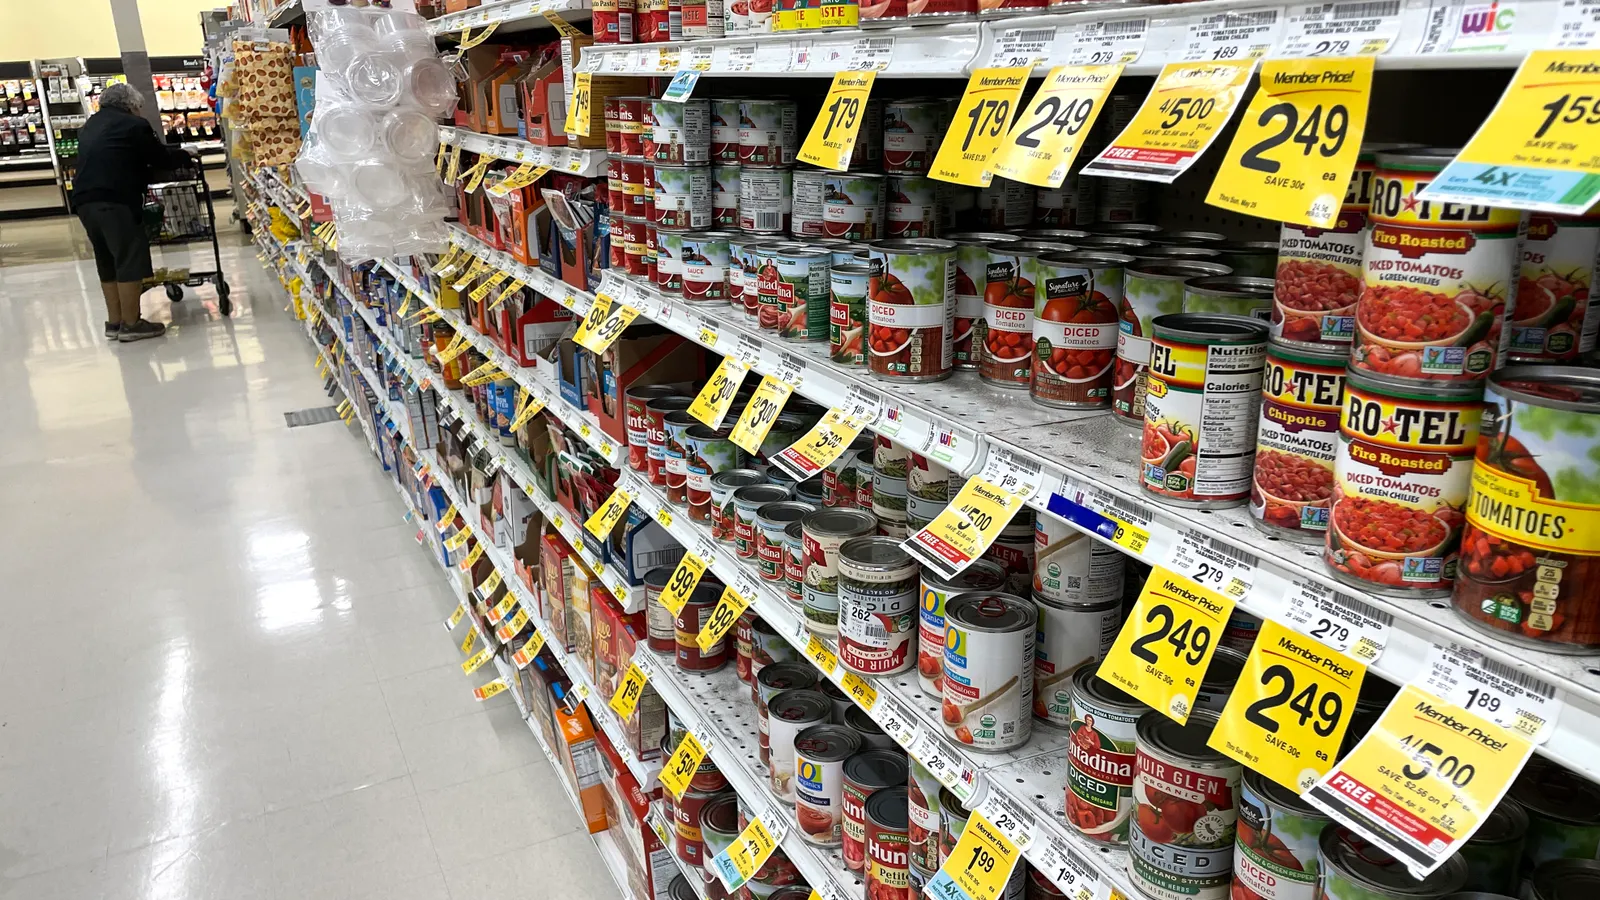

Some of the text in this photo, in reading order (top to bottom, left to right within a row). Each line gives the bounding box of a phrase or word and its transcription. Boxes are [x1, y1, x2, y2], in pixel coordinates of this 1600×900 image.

[1461, 1, 1516, 34] wic
[1212, 46, 1238, 60] 189
[1308, 40, 1350, 56] 279
[979, 76, 1023, 86] Member Price!
[1055, 74, 1110, 83] Member Price!
[1274, 70, 1356, 84] Member Price!
[575, 88, 589, 117] 149
[822, 96, 859, 140] 179
[961, 98, 1010, 152] 179
[1015, 96, 1094, 149] 249
[1240, 102, 1349, 174] 249
[1106, 147, 1138, 159] FREE
[1264, 175, 1305, 190] SAVE 30¢
[1322, 172, 1337, 181] ea
[1472, 166, 1520, 187] 4X
[1299, 239, 1354, 254] TOMATOES
[1374, 230, 1467, 250] Fire Roasted
[687, 267, 704, 275] SAUCE
[1369, 260, 1464, 280] DICED TOMATOES
[1384, 273, 1408, 283] GREEN
[1409, 275, 1440, 286] CHILIES
[1048, 280, 1080, 294] Signature
[760, 295, 777, 304] PAST
[872, 304, 895, 316] DICED
[995, 309, 1026, 321] DICED
[994, 318, 1026, 329] Tomatoes
[1063, 327, 1100, 337] DICED
[1063, 335, 1100, 346] Tomatoes
[1207, 382, 1250, 391] Calories
[887, 405, 903, 422] wic
[1268, 407, 1327, 427] Chipotle
[939, 429, 958, 449] wic
[1279, 432, 1333, 452] TOMATOES
[1352, 445, 1443, 471] Fire Roasted
[1000, 473, 1017, 487] 189
[1347, 472, 1441, 498] DICED TOMATOES
[1490, 481, 1520, 499] CHILES
[1365, 486, 1389, 497] GREEN
[1390, 491, 1420, 503] CHILIES
[600, 502, 623, 522] 199
[1475, 491, 1567, 539] TOMATOES
[919, 530, 939, 546] FREE
[1192, 562, 1223, 583] 279
[1543, 568, 1555, 577] 25
[1162, 579, 1201, 604] Member
[1197, 596, 1224, 615] Price!
[851, 606, 871, 622] 262
[1301, 590, 1382, 630] ROTEL FIRE ROASTED DICED
[1320, 604, 1340, 618] GREEN
[1340, 614, 1364, 629] CHILIES
[1130, 604, 1211, 667] 249
[1309, 618, 1349, 642] 279
[815, 652, 827, 663] 429
[841, 647, 900, 671] MUIR GLEN
[1278, 636, 1354, 680] Member Price!
[1145, 664, 1175, 686] SAVE 30¢
[1184, 677, 1196, 687] ea
[1464, 670, 1516, 698] GREEN CHILES
[622, 678, 639, 701] 199
[852, 684, 865, 698] 429
[946, 677, 976, 696] Tomatoes
[1245, 664, 1343, 738] 249
[1465, 687, 1501, 713] 189
[885, 718, 901, 732] 229
[1415, 701, 1508, 752] Member Price!
[1265, 733, 1301, 759] SAVE 30¢
[1315, 749, 1329, 762] ea
[927, 755, 946, 771] 229
[1069, 766, 1107, 794] DICED
[1136, 753, 1220, 796] MUIR GLEN
[1142, 775, 1199, 801] ORGANIC
[1333, 775, 1376, 806] FREE
[1377, 764, 1449, 809] SAVE $2.56 on 4
[995, 814, 1016, 831] 229
[975, 821, 1011, 856] Member Price!
[1131, 827, 1211, 868] DICED
[869, 838, 908, 865] Hun
[967, 845, 995, 873] 199
[1143, 851, 1184, 873] TOMATOES
[1266, 862, 1287, 875] GREEN
[1289, 870, 1314, 880] PEPPER
[885, 878, 907, 886] DICED
[1056, 867, 1075, 885] 199
[1143, 872, 1190, 893] ITALIAN HERBS
[1241, 858, 1276, 887] DICED
[1240, 869, 1276, 897] Tomatoes
